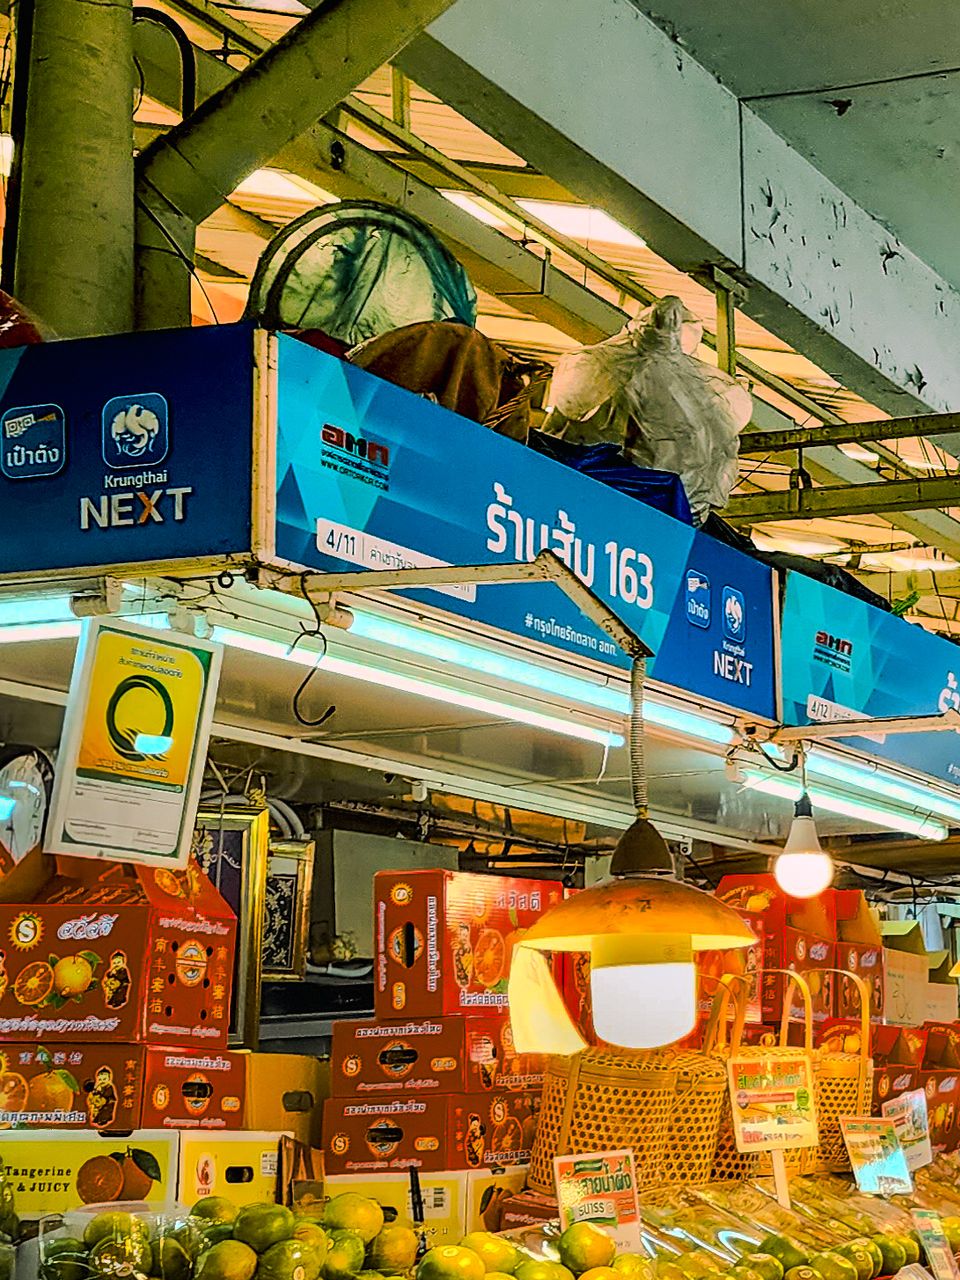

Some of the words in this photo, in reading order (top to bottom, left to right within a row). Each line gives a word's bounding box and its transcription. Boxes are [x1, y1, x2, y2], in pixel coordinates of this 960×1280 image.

[6, 444, 60, 467] เป๋าตัง
[104, 470, 168, 489] Krungthai
[79, 486, 193, 531] NEXT
[326, 529, 356, 556] 4/11
[604, 541, 655, 610] 163
[713, 650, 754, 687] NEXT
[810, 700, 829, 719] 4/12
[5, 1165, 72, 1179] Tangerine
[16, 1182, 26, 1192] &
[29, 1182, 71, 1192] JUICY
